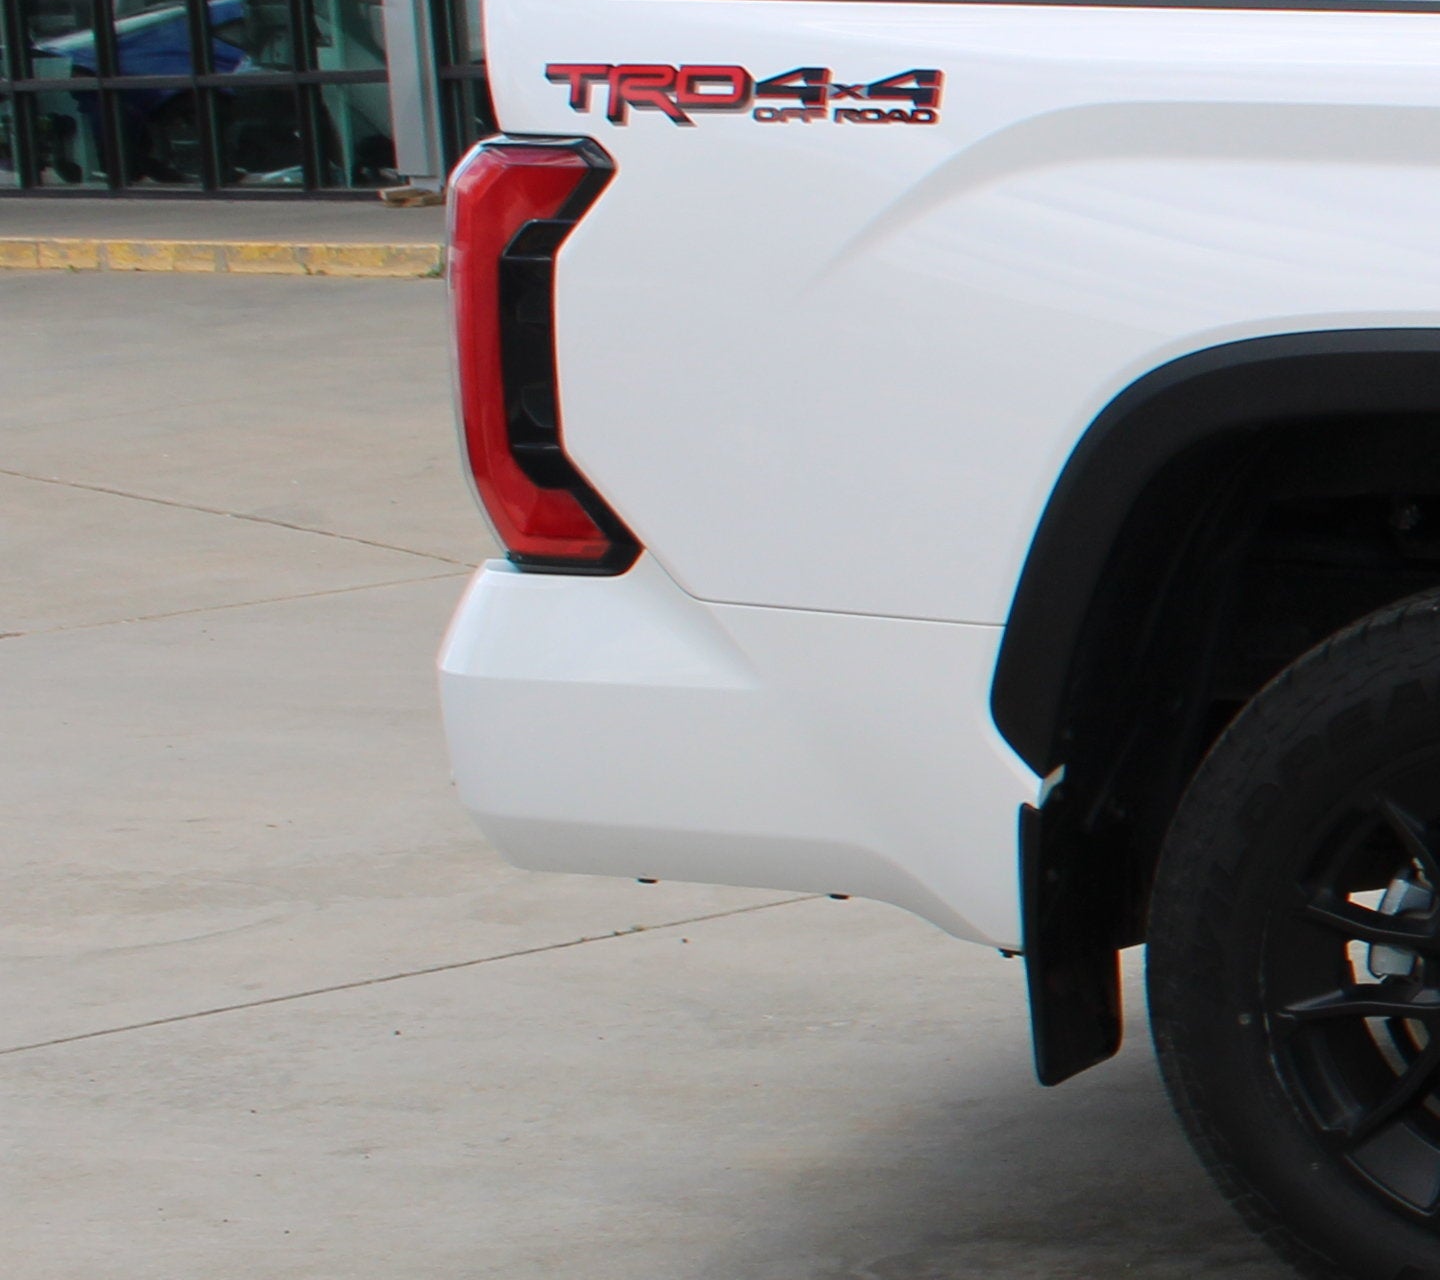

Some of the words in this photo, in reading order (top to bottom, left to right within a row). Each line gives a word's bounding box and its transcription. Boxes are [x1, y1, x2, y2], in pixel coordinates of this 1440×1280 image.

[545, 62, 753, 127] TRD
[754, 67, 945, 109] 4x4
[753, 107, 828, 124] OFF
[833, 108, 941, 124] ROAD
